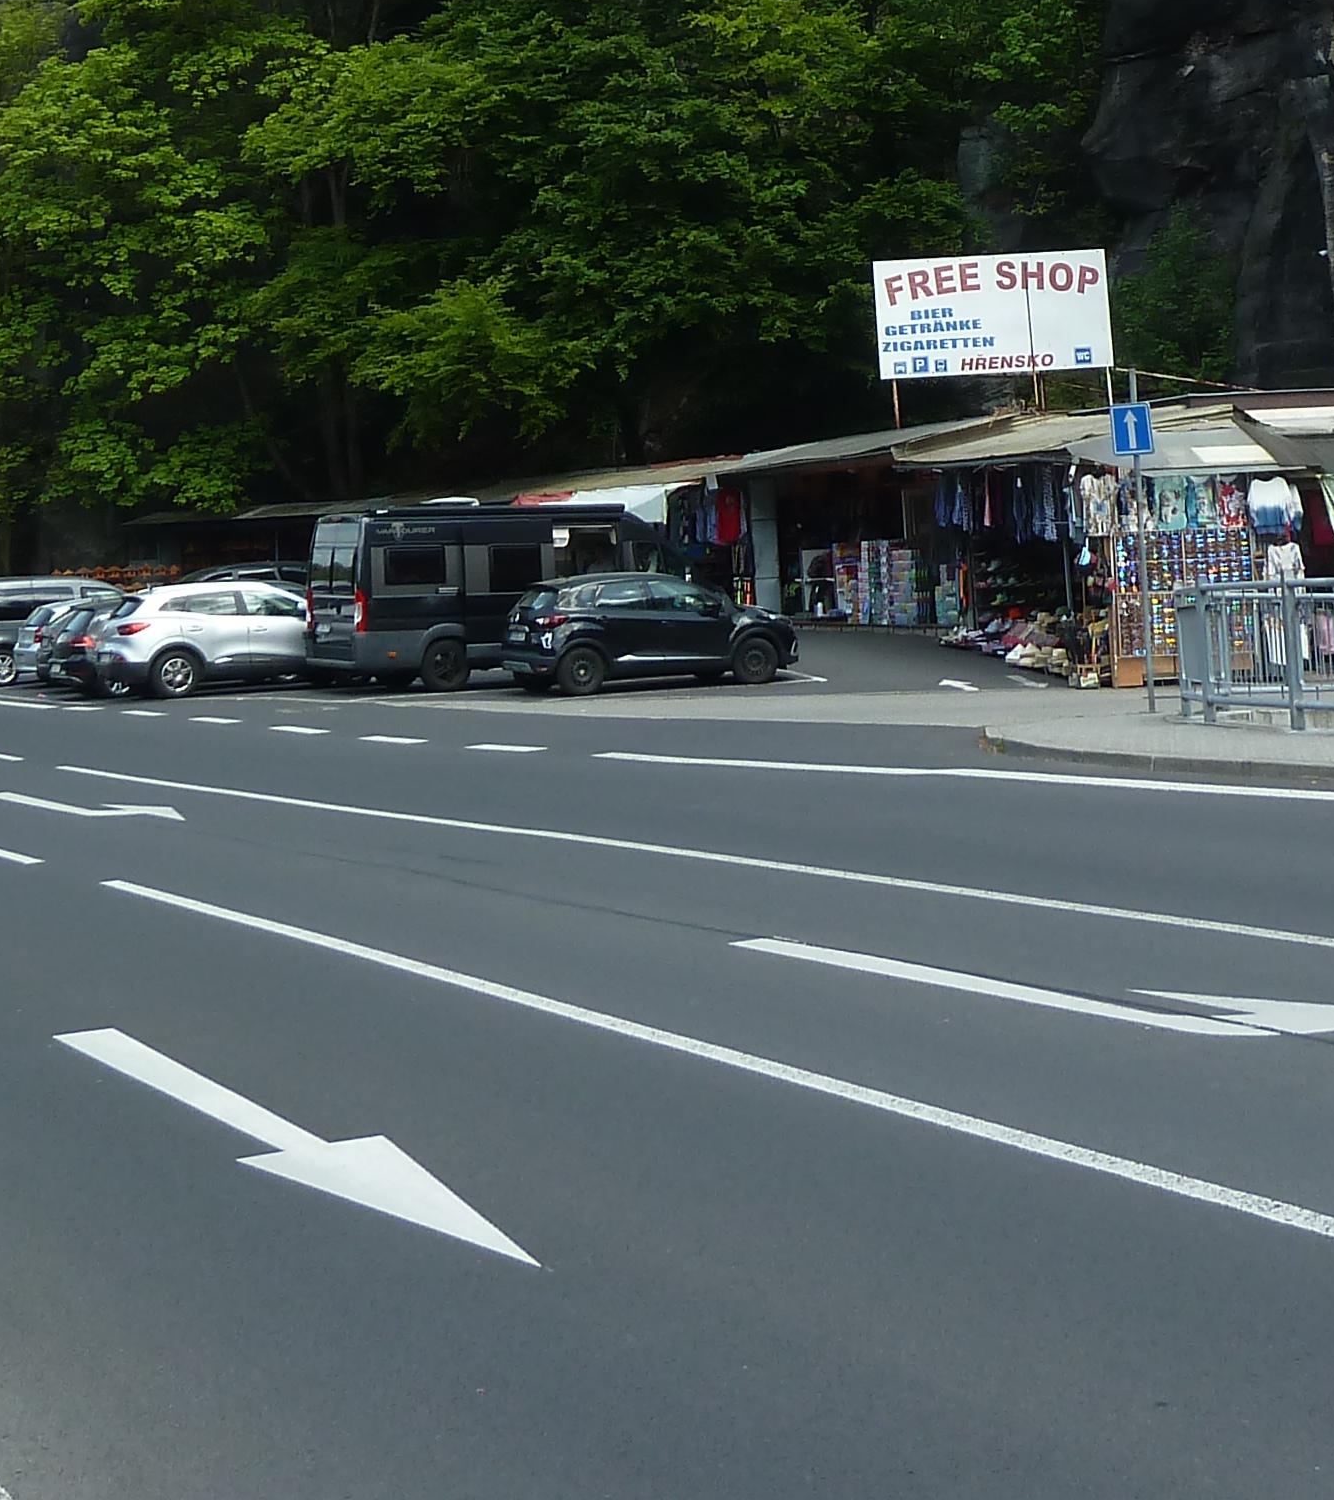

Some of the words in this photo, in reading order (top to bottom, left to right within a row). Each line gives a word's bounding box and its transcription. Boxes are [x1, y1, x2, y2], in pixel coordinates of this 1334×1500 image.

[884, 262, 981, 307] FREE
[995, 260, 1100, 294] SHOP
[910, 307, 954, 321] BIER
[884, 318, 982, 337] GETRÄNKE
[882, 336, 996, 353] ZIGARETTEN
[960, 353, 1055, 372] HŘENSKO
[1075, 350, 1091, 362] WC
[916, 359, 926, 371] P
